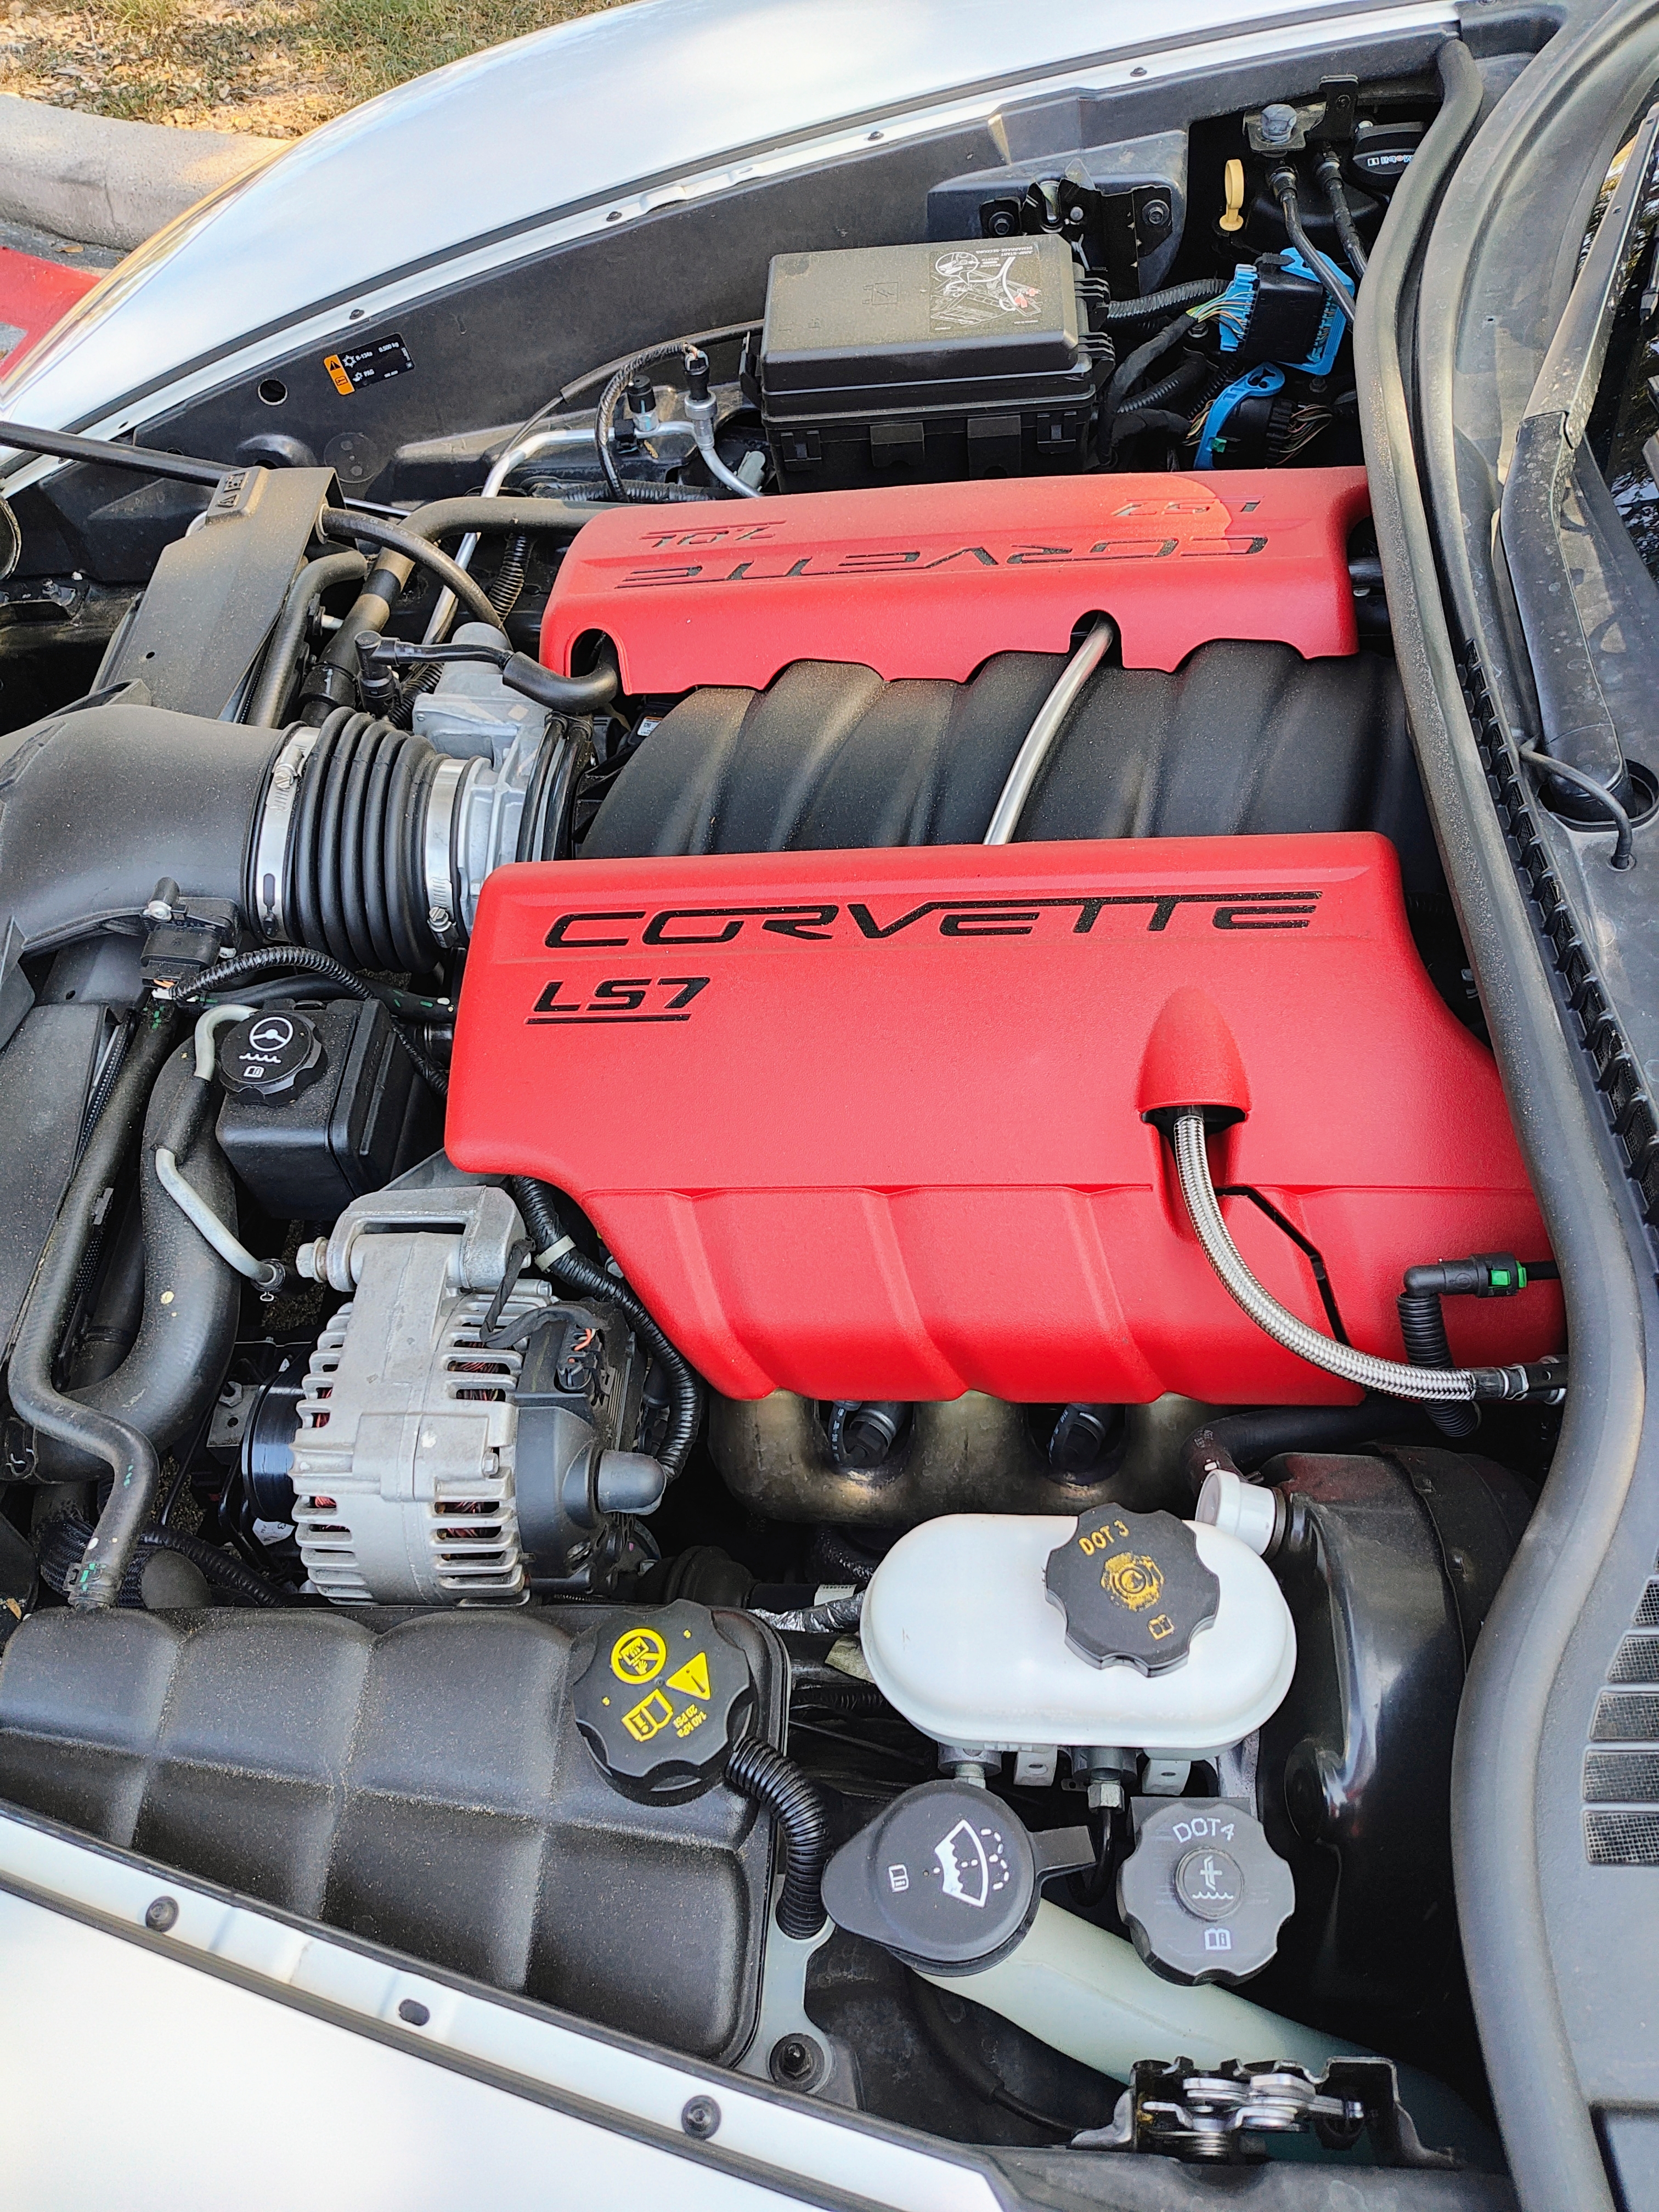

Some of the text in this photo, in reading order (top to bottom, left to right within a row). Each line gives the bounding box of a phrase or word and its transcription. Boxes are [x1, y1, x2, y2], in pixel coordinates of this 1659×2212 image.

[1380, 154, 1414, 164] Mobil
[355, 351, 373, 362] R-134a
[363, 369, 375, 377] PAG
[614, 534, 1269, 589] CORVETTE
[544, 890, 1323, 949] CORVETTE
[533, 977, 710, 1013] LS7
[1078, 1519, 1129, 1556] DOT 3
[673, 1703, 698, 1729] 20 PSI
[691, 1711, 707, 1728] 140
